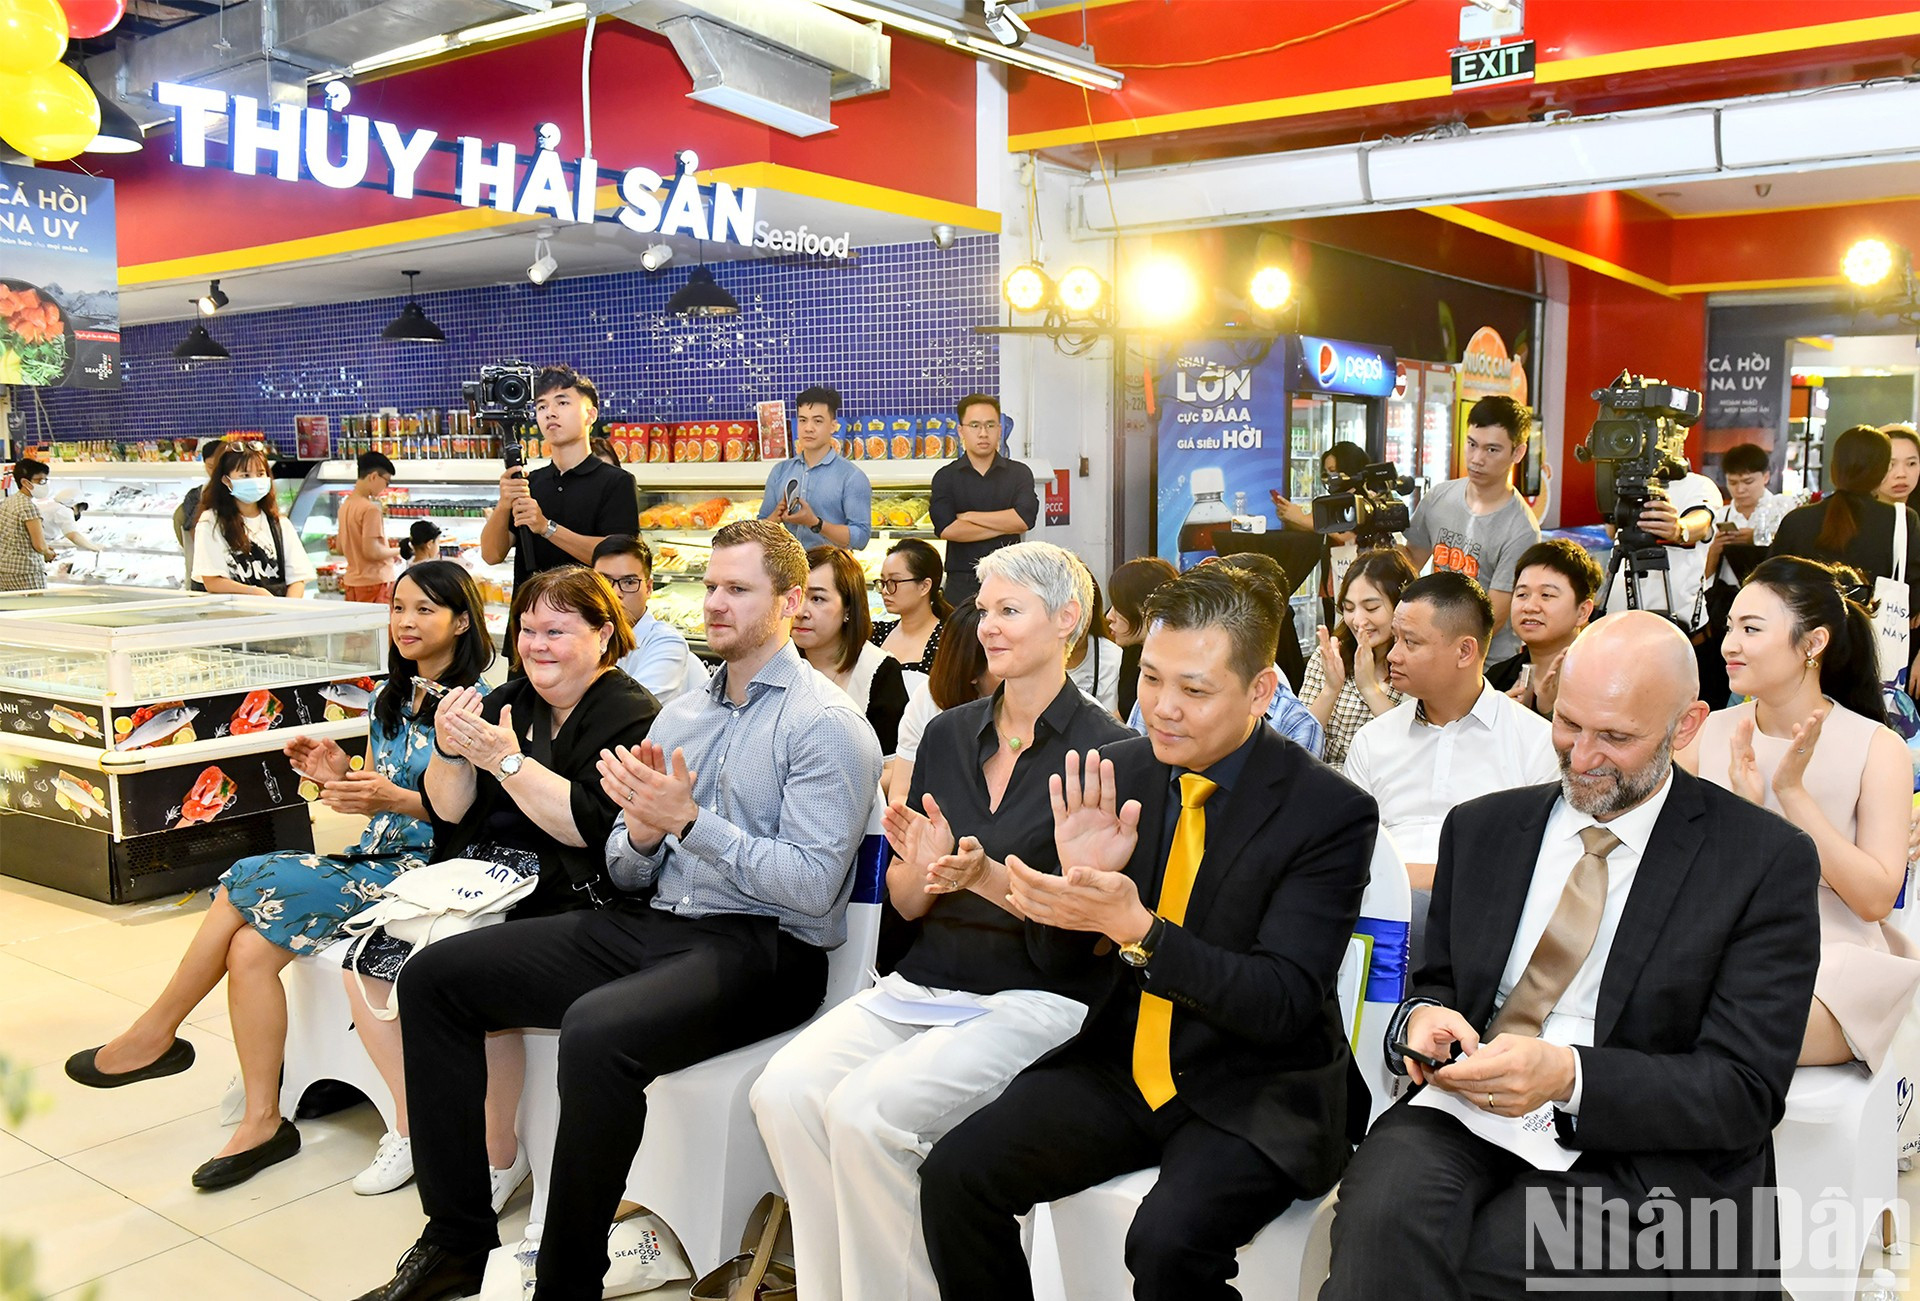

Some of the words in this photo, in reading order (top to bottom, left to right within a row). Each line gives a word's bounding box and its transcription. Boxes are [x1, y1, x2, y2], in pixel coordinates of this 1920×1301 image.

[1459, 46, 1525, 82] EXIT
[156, 80, 439, 200] THỦY
[459, 121, 598, 224] HẢI
[617, 148, 757, 247] SẢN
[38, 184, 87, 215] HỒI
[43, 216, 80, 240] UY
[753, 220, 850, 259] Seafood
[1344, 354, 1383, 384] pepsi
[1709, 354, 1732, 372] CÁ
[1737, 352, 1770, 371] HỒI
[1711, 377, 1736, 391] NA
[1742, 376, 1767, 390] UY
[615, 1249, 661, 1258] SEAFOOD
